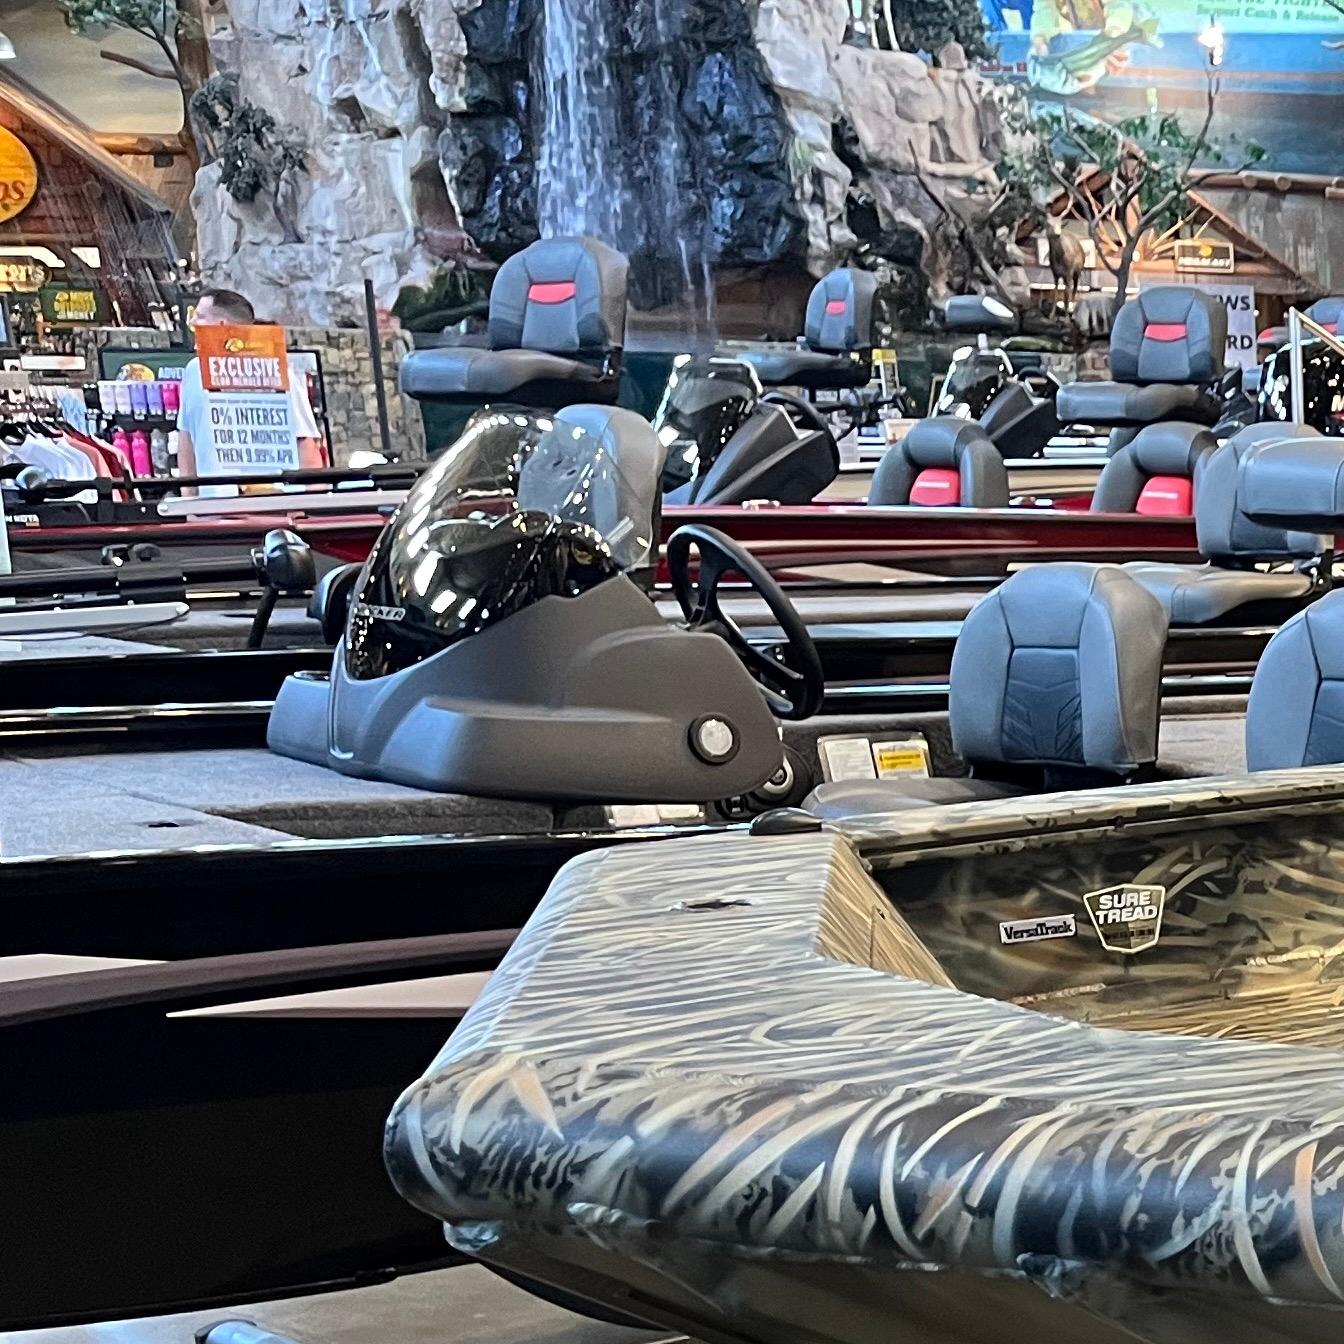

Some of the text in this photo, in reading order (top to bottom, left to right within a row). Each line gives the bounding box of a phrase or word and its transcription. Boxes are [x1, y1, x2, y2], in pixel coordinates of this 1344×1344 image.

[208, 356, 281, 377] EXCLUSIVE
[211, 407, 288, 426] 0% INTEREST
[214, 428, 291, 445] FOR 12 MONTHS
[216, 447, 243, 463] THEN
[277, 449, 294, 464] APR
[1098, 890, 1151, 910] SURE
[1096, 905, 1158, 925] TREAD
[1003, 921, 1074, 941] VersaTrack
